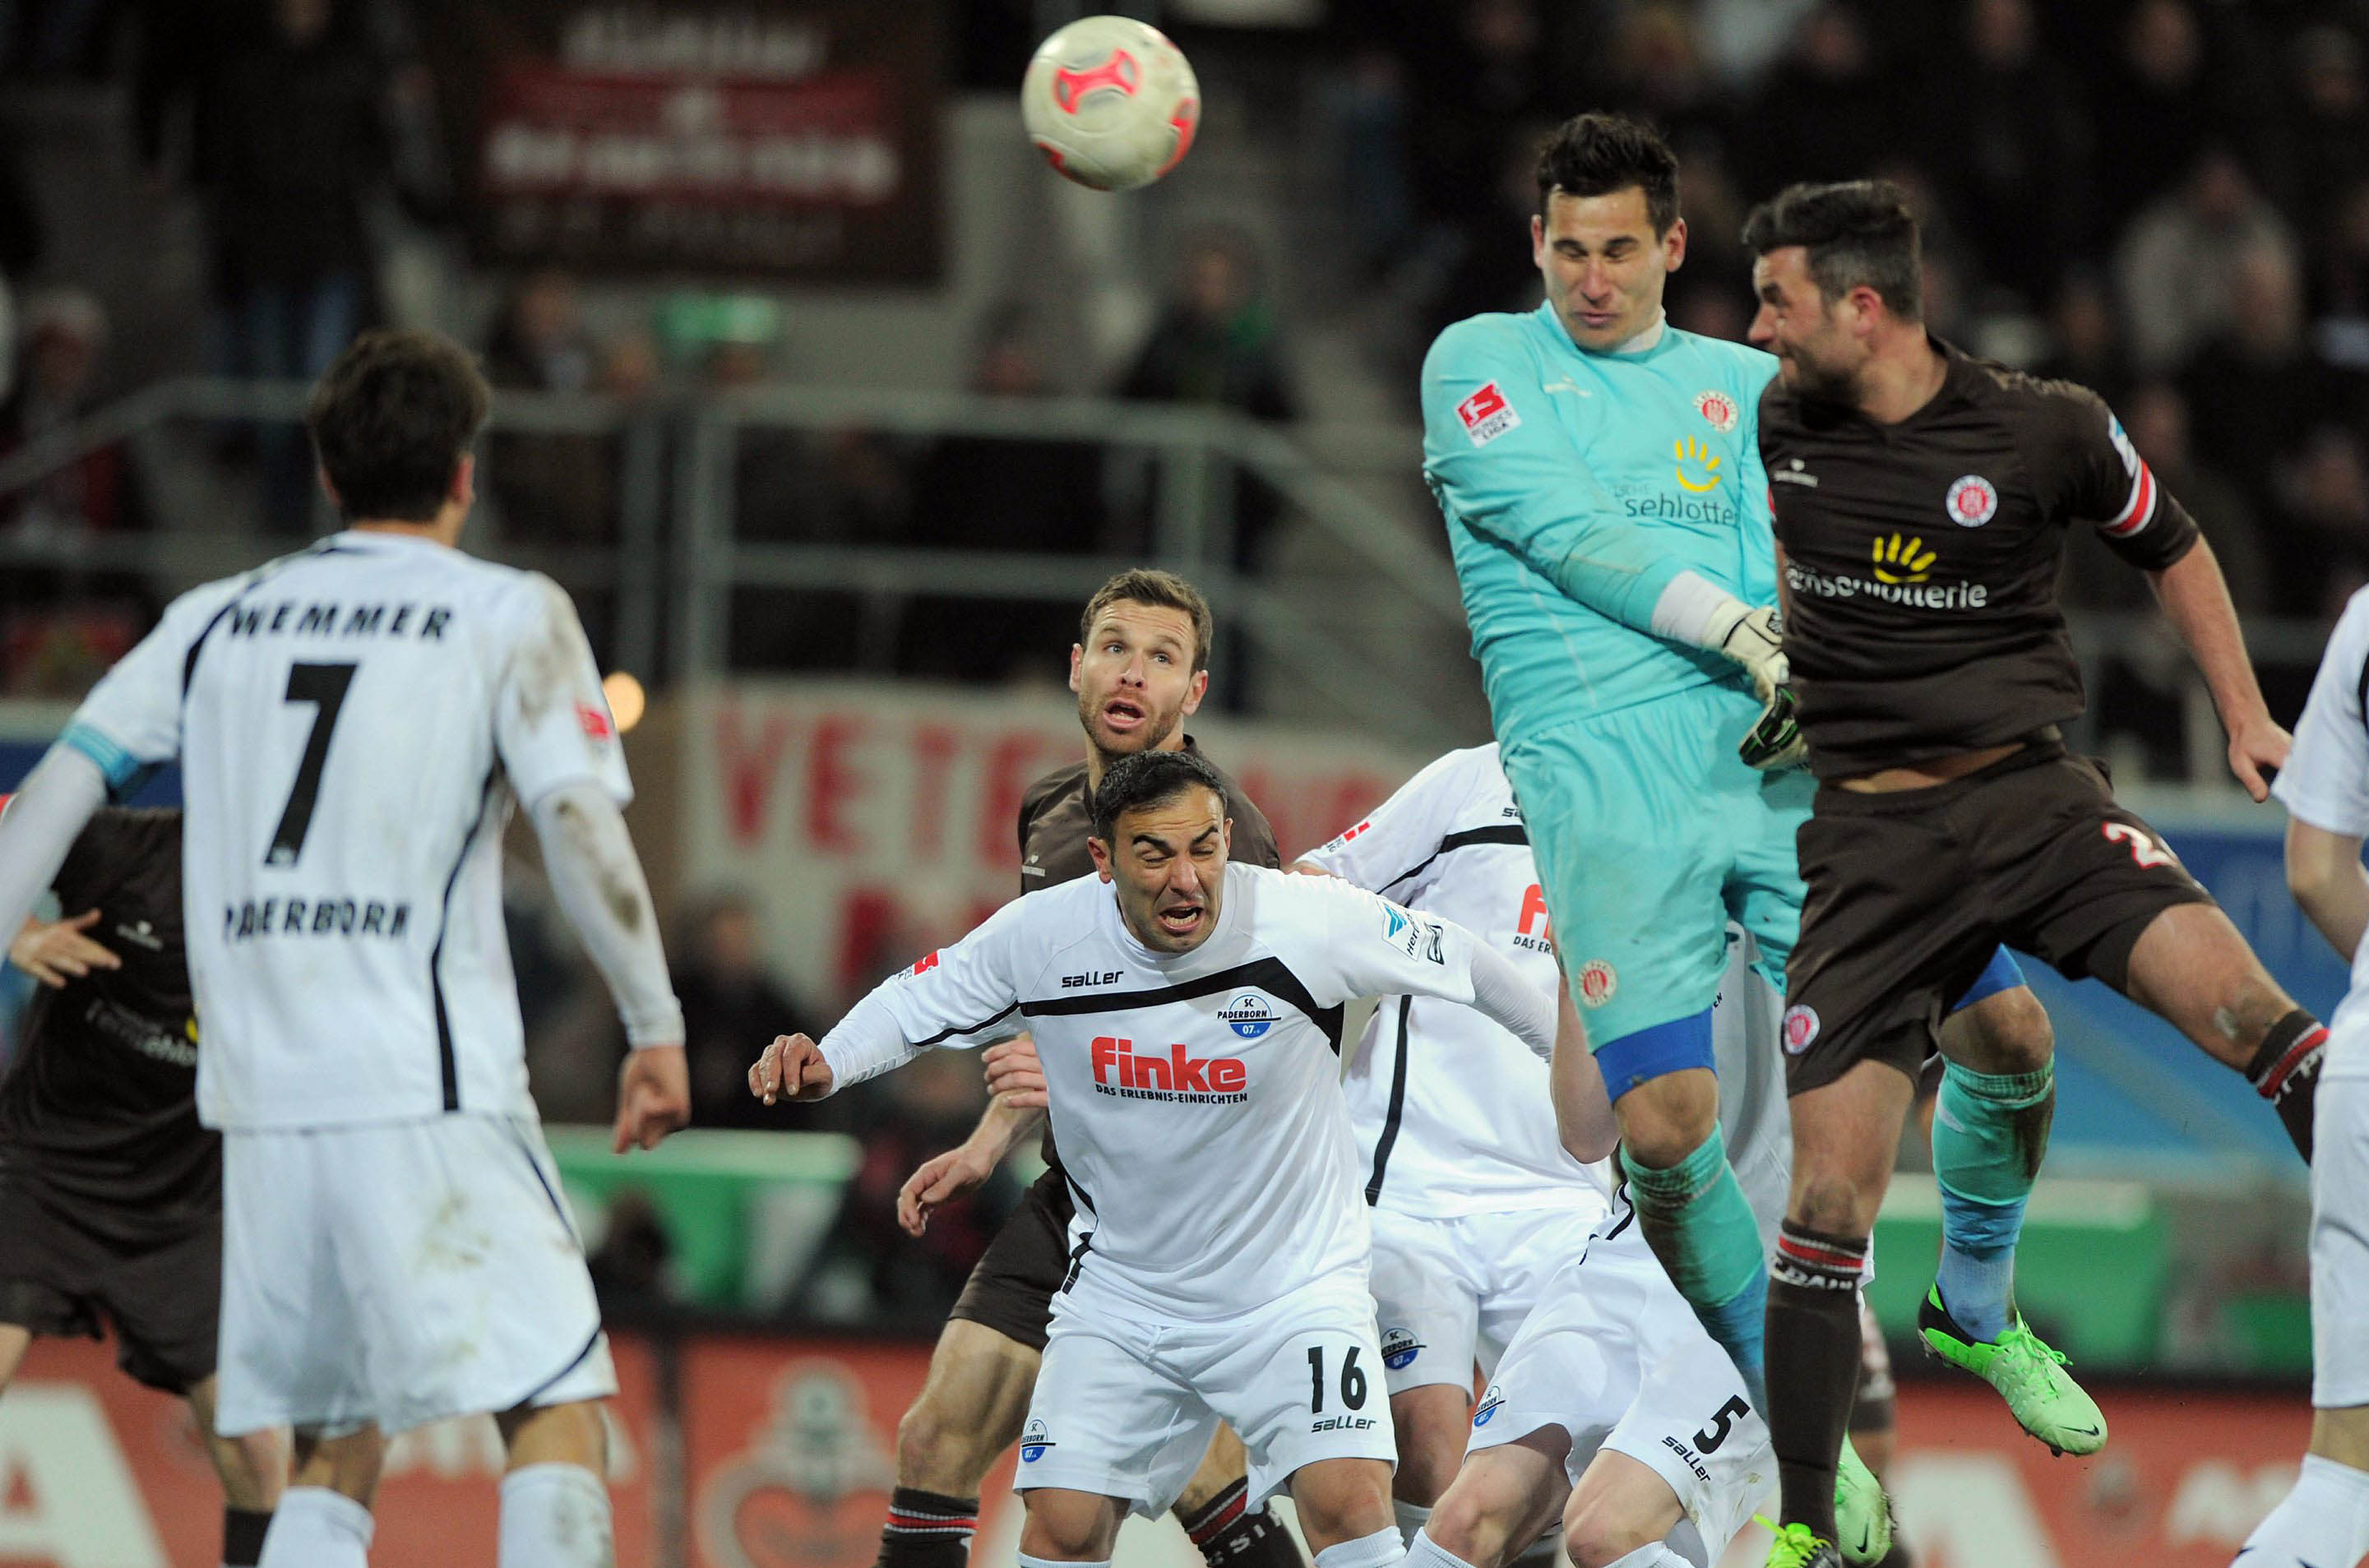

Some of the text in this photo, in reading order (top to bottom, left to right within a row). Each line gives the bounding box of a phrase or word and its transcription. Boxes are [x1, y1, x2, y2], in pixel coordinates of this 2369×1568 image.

[229, 602, 453, 641] WEMMER
[264, 663, 359, 866] 7
[1513, 936, 1534, 950] DAS
[1062, 970, 1124, 988] saller
[1217, 1010, 1267, 1020] PADERBORN
[1243, 998, 1254, 1007] SC
[1091, 1036, 1247, 1093] finke
[1095, 1083, 1248, 1105] DAS ERLEBNIS-EINRICHTEN
[1307, 1346, 1367, 1414] 16
[1312, 1415, 1377, 1433] saller
[1692, 1394, 1751, 1455] 5
[1662, 1436, 1711, 1482] saller
